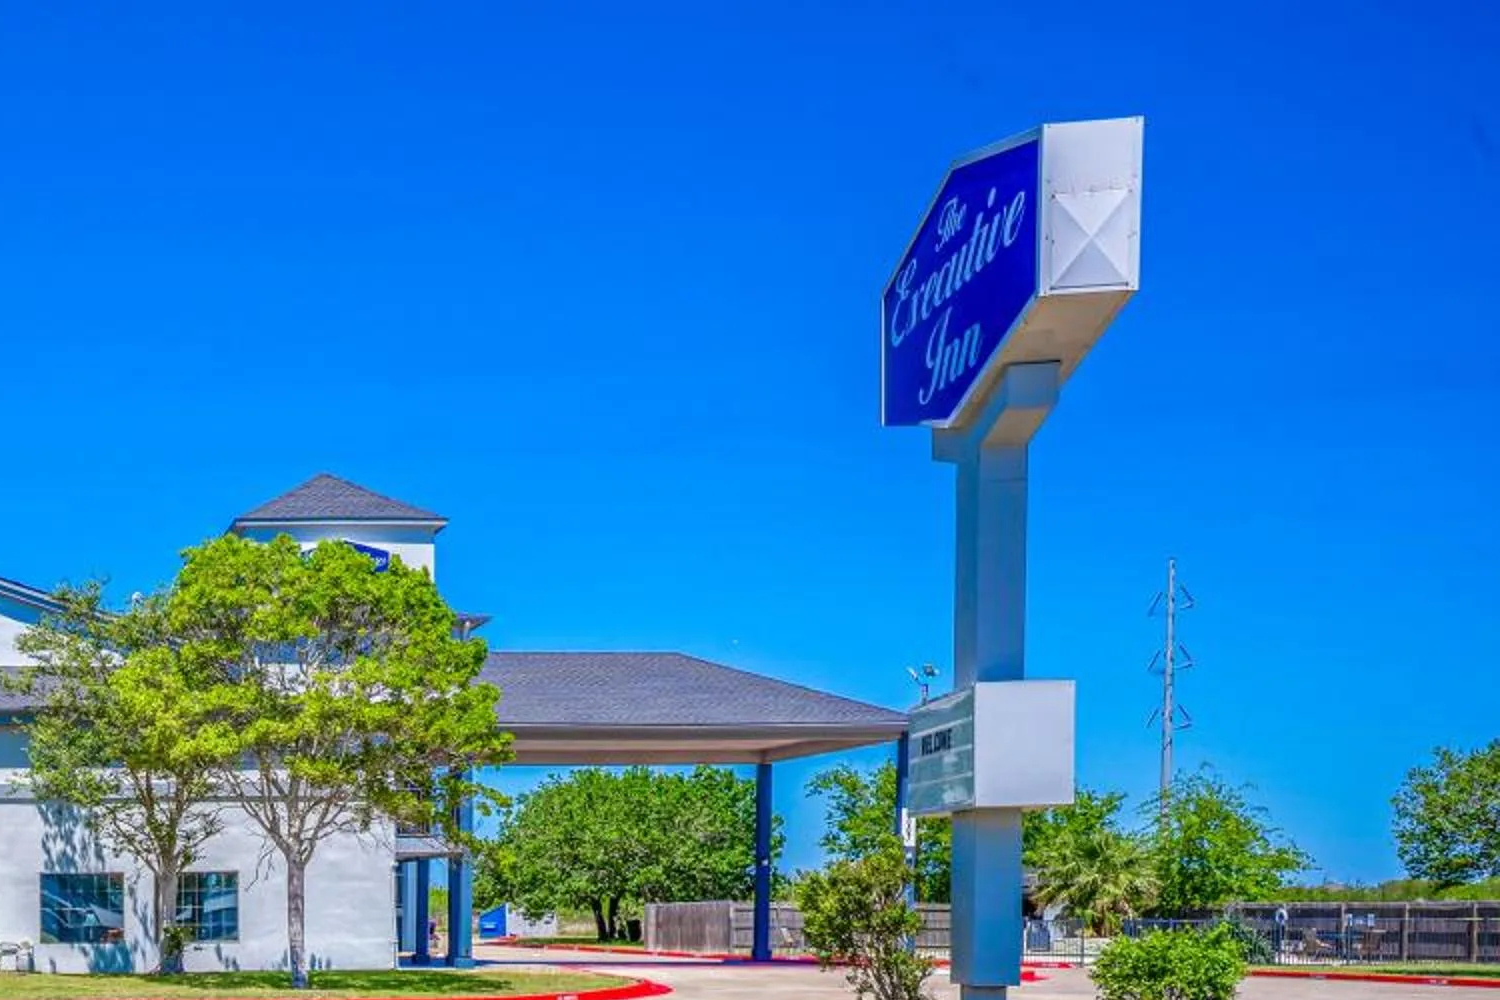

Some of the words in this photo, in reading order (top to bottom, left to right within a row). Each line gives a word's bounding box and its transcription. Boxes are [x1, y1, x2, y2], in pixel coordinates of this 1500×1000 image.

[891, 186, 1025, 347] Executive
[935, 196, 967, 252] The
[919, 306, 983, 405] Inn
